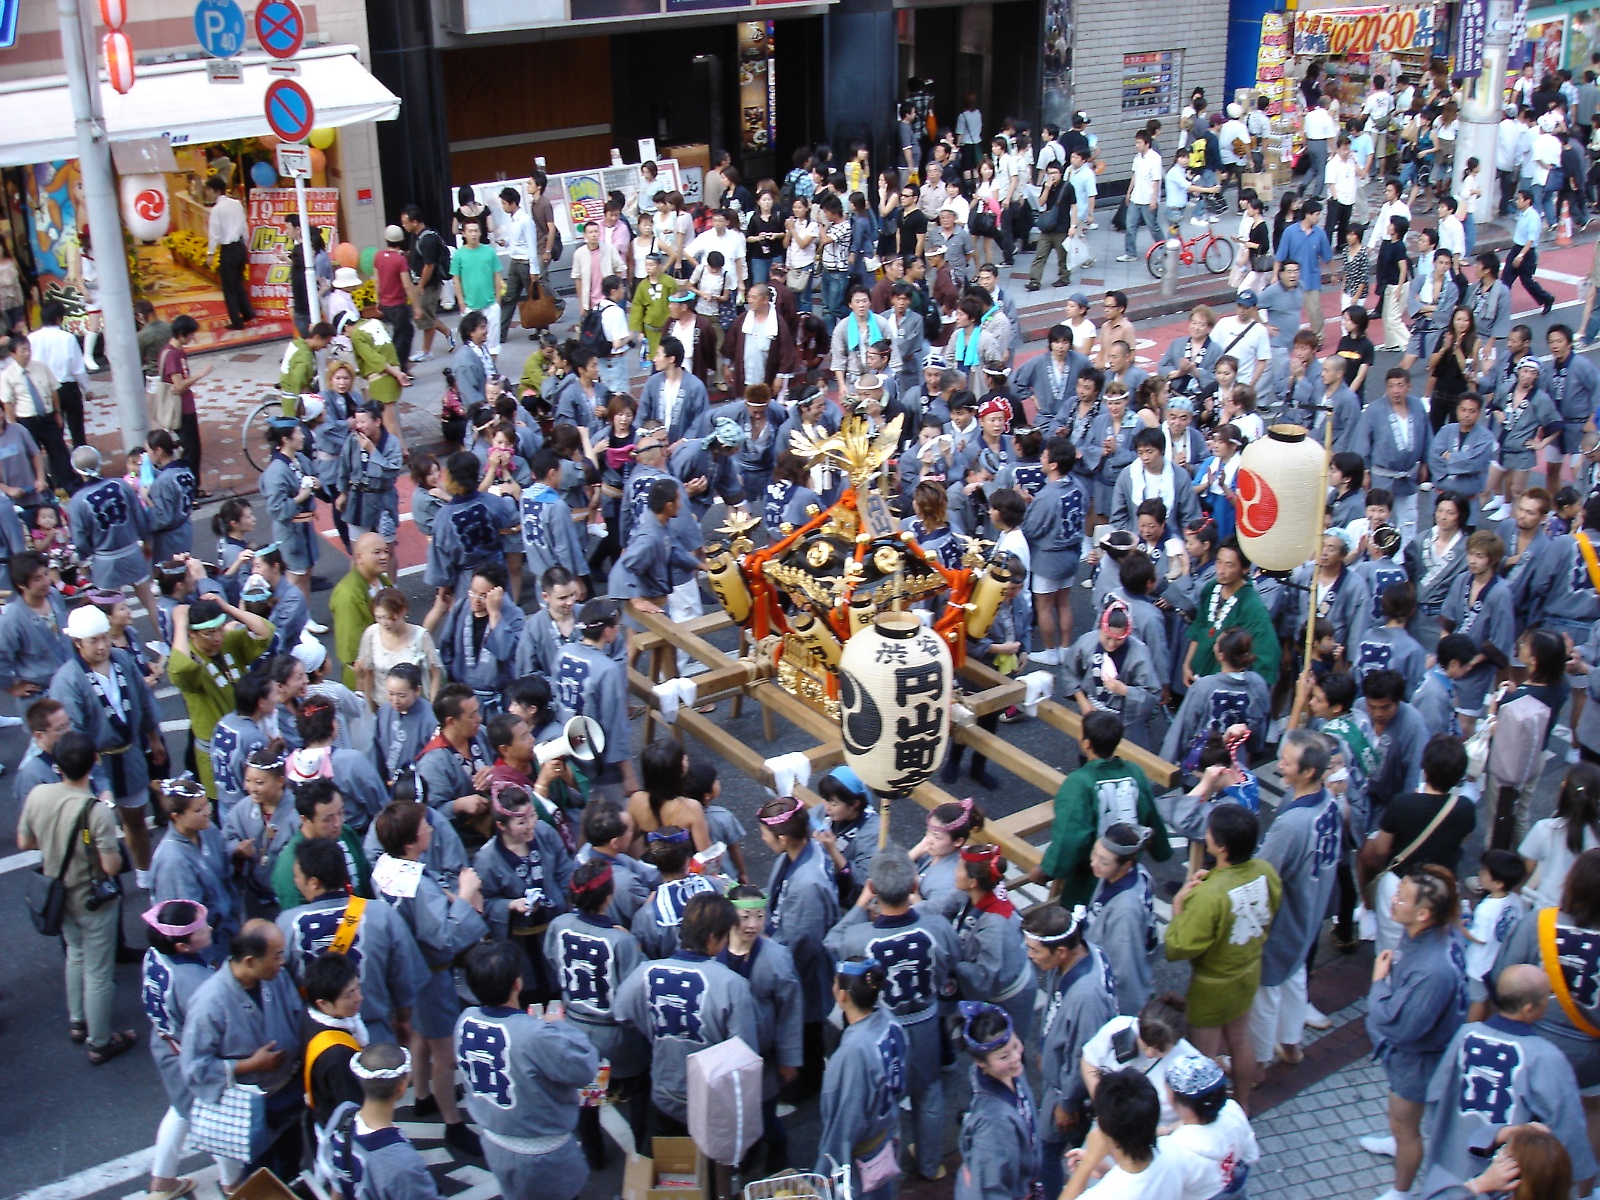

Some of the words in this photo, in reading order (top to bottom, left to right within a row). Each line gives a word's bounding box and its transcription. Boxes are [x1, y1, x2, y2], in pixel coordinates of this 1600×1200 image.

[204, 10, 225, 51] P
[250, 201, 273, 219] 19
[876, 636, 940, 665] 渋谷
